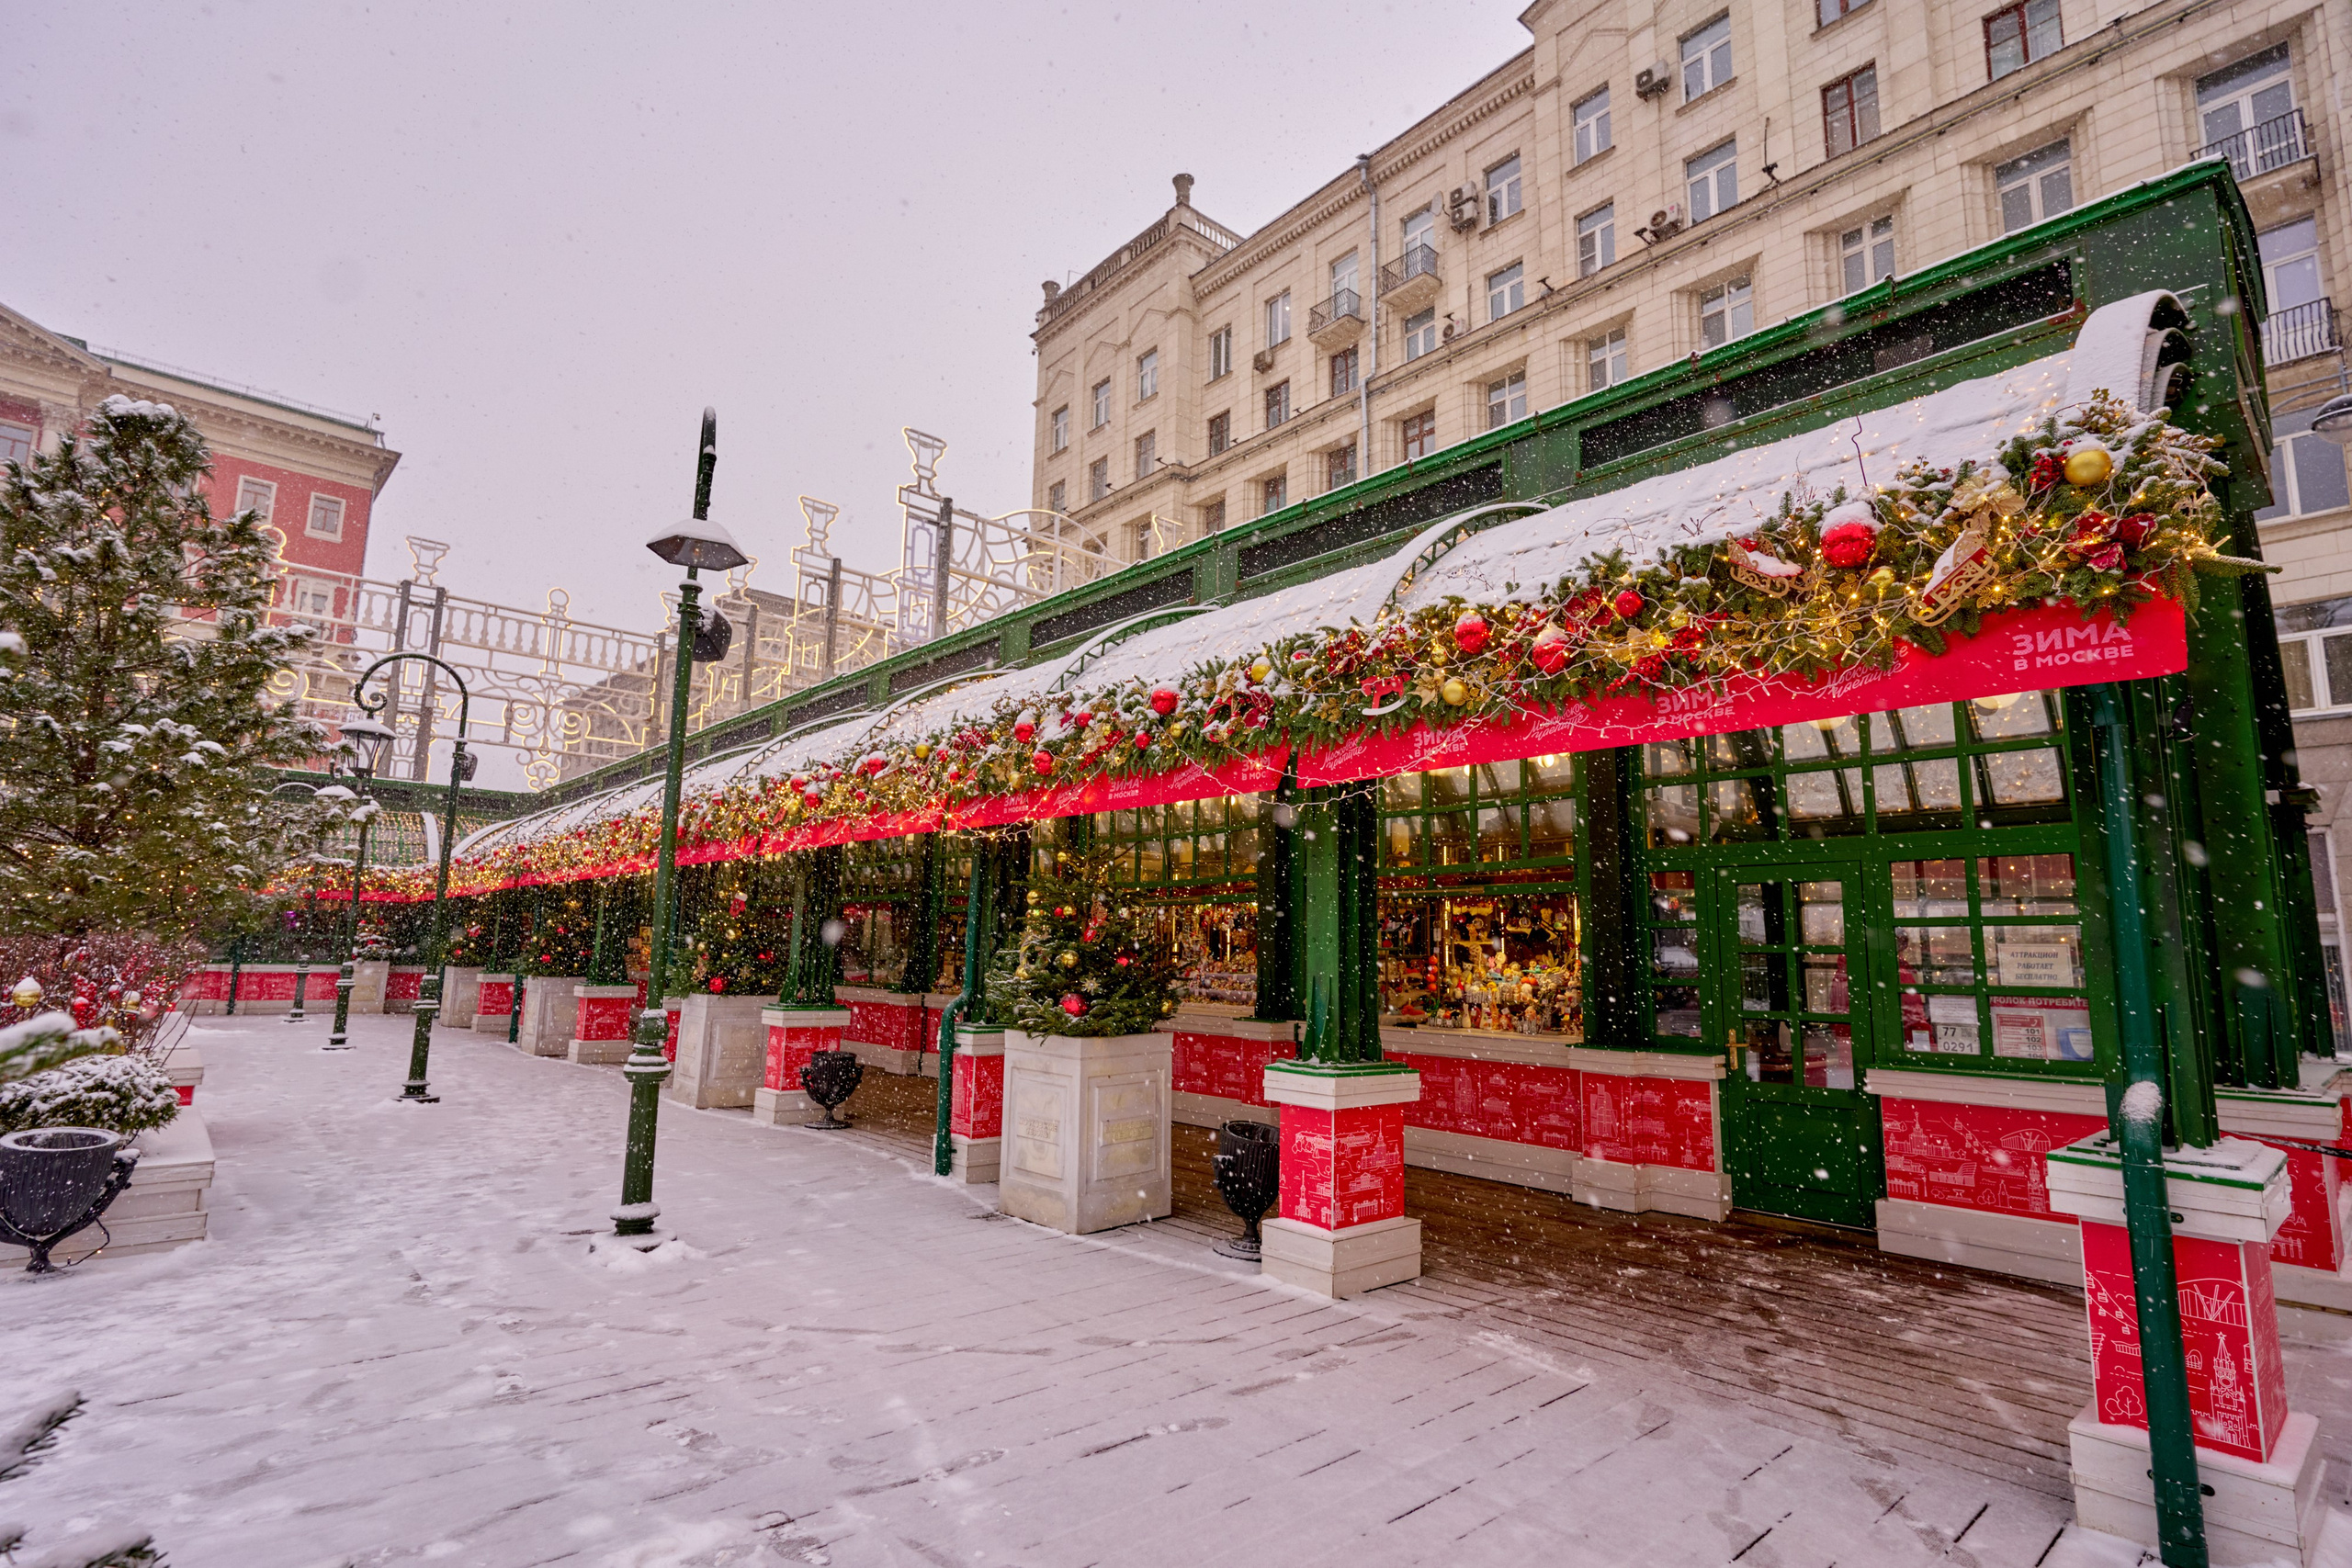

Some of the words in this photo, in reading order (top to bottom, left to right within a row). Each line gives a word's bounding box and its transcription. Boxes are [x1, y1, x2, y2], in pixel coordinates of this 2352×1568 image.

[2012, 620, 2132, 656] ЗИМА
[2014, 659, 2029, 671] В
[2035, 644, 2134, 668] МОСКВЕ
[1657, 690, 1735, 714] ЗИМА
[1671, 706, 1735, 726] МОСКВЕ
[1413, 728, 1464, 747] ЗИМА
[1414, 749, 1421, 758] В
[1242, 773, 1247, 781] В
[1942, 1027, 1957, 1037] 77
[1943, 1042, 1973, 1053] 0291
